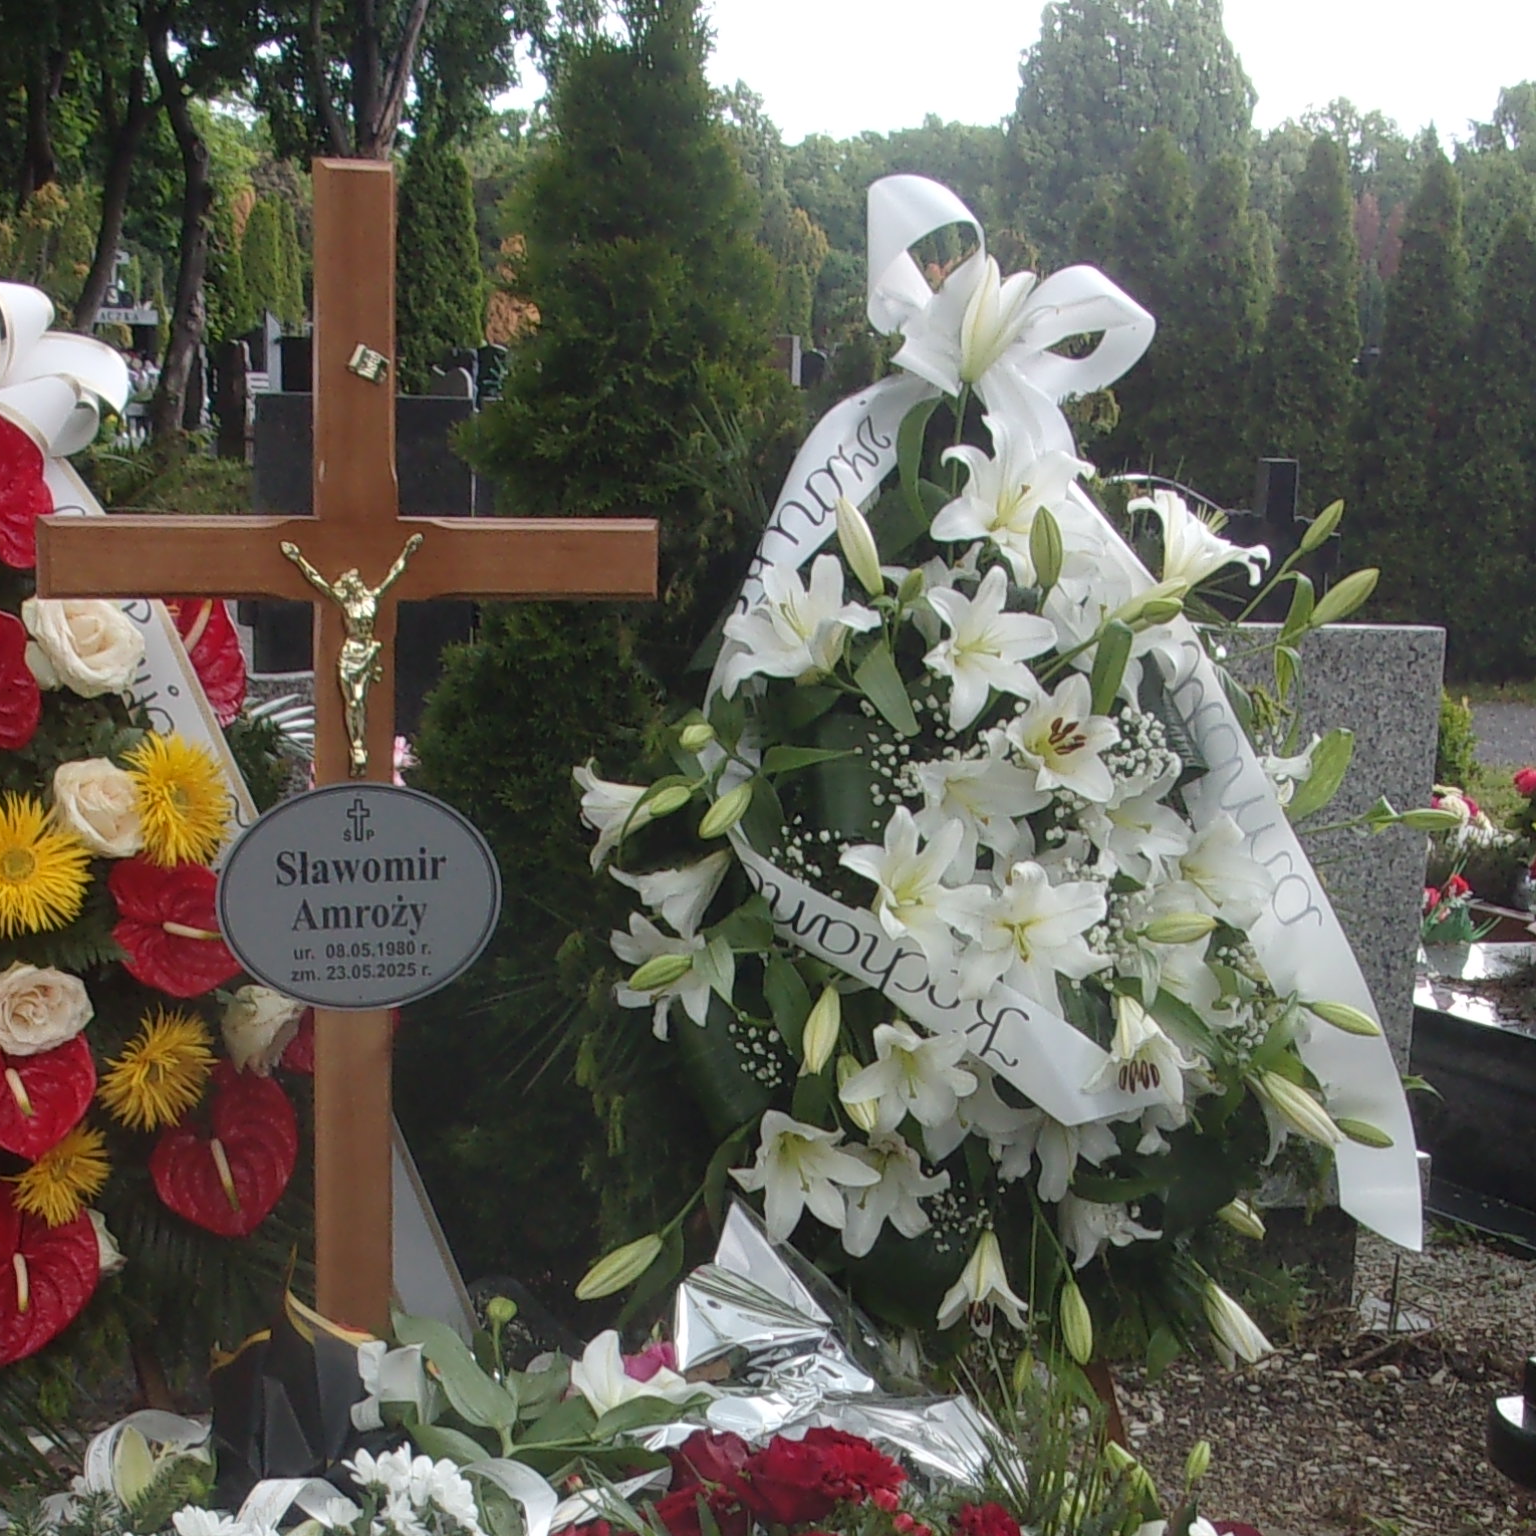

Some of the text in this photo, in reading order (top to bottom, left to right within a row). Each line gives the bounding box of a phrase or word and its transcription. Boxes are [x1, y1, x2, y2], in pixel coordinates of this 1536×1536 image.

[276, 847, 446, 886] Sławomir
[292, 895, 427, 935] Amroży
[294, 941, 432, 960] ur. 08.05.1980 r.
[291, 963, 432, 982] zm. 23.05.2025 r.
